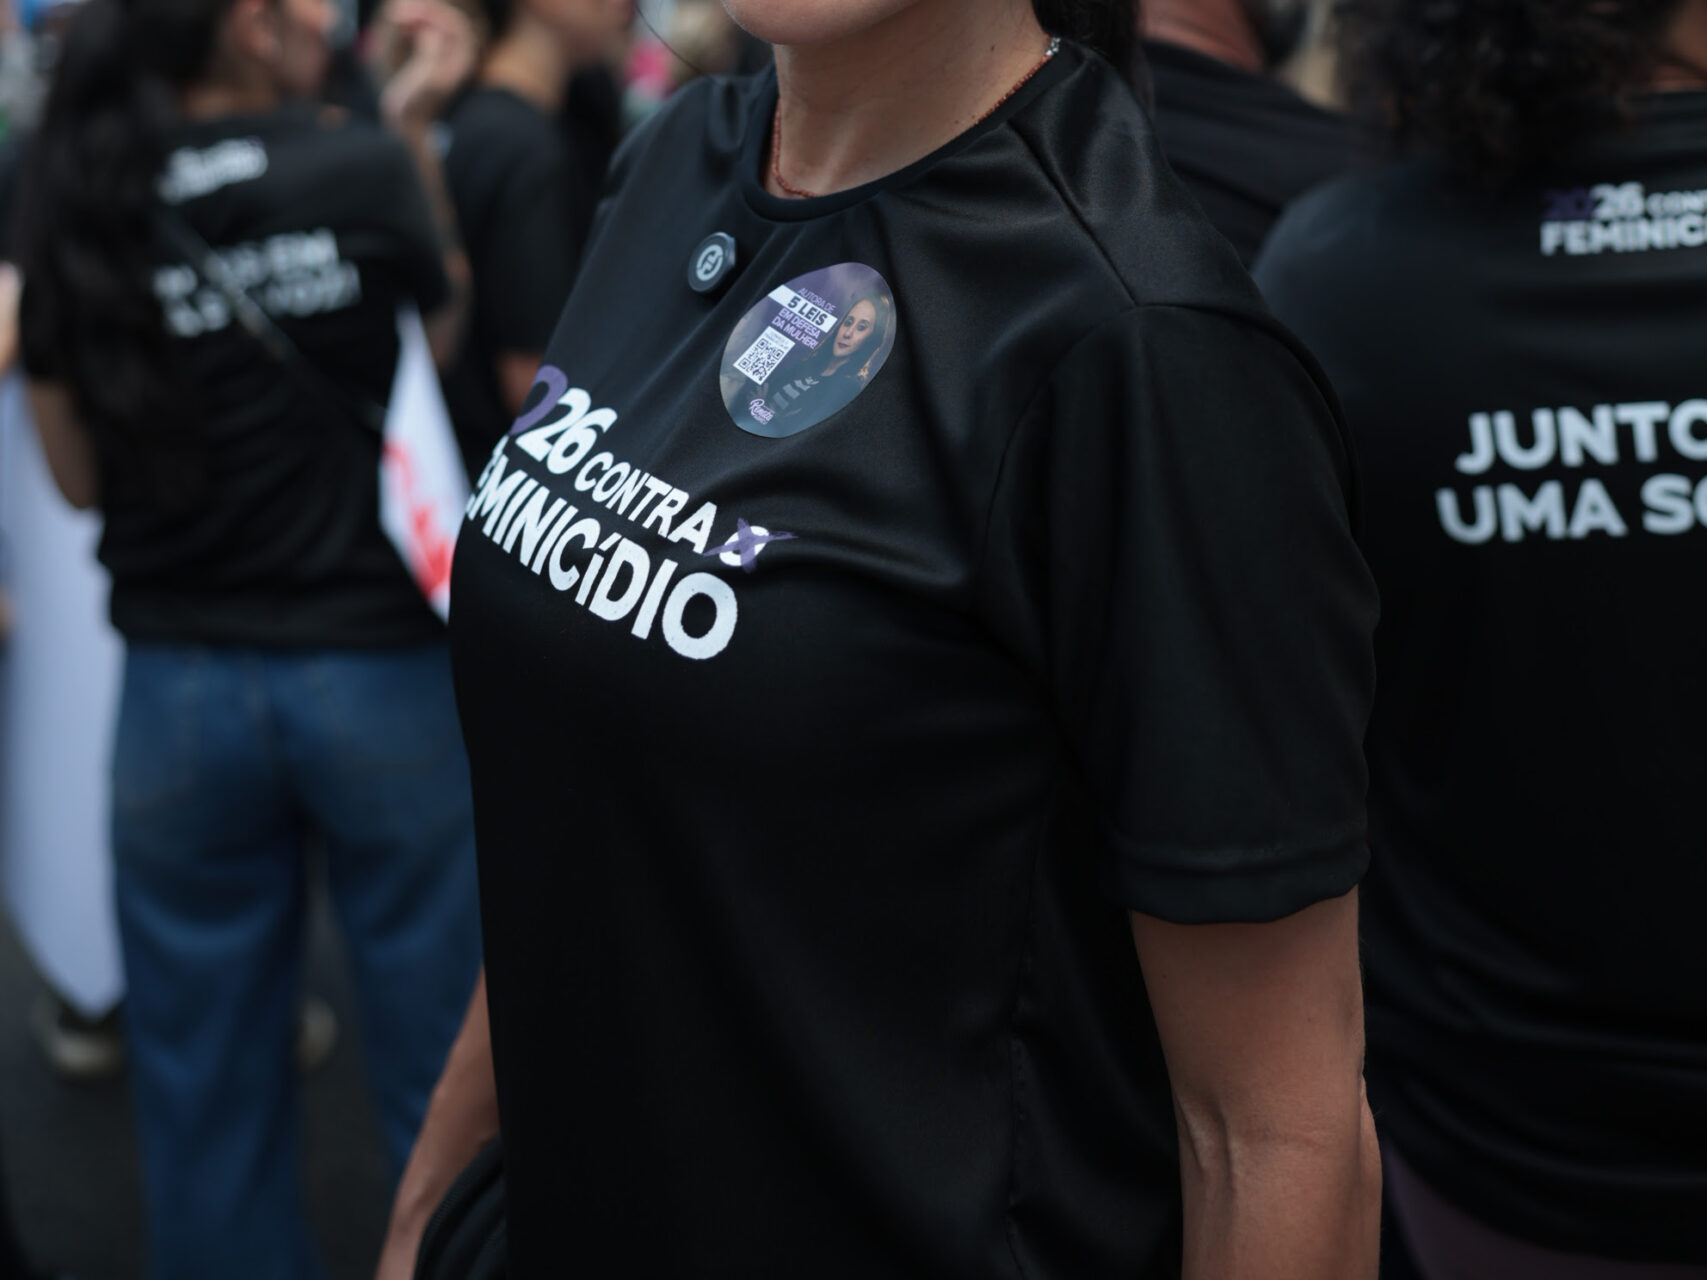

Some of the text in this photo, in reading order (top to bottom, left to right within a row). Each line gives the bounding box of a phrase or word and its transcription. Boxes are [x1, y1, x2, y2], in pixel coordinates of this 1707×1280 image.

[1543, 182, 1644, 219] 2026
[1540, 213, 1707, 255] FEMINIC
[787, 296, 828, 326] 5 LEIS
[798, 288, 836, 313] AUTORA DE
[771, 316, 783, 329] DA
[783, 322, 819, 349] MULHER!
[779, 308, 821, 338] EM DEFESA
[574, 451, 717, 554] CONTRA
[1435, 473, 1707, 544] UMA S
